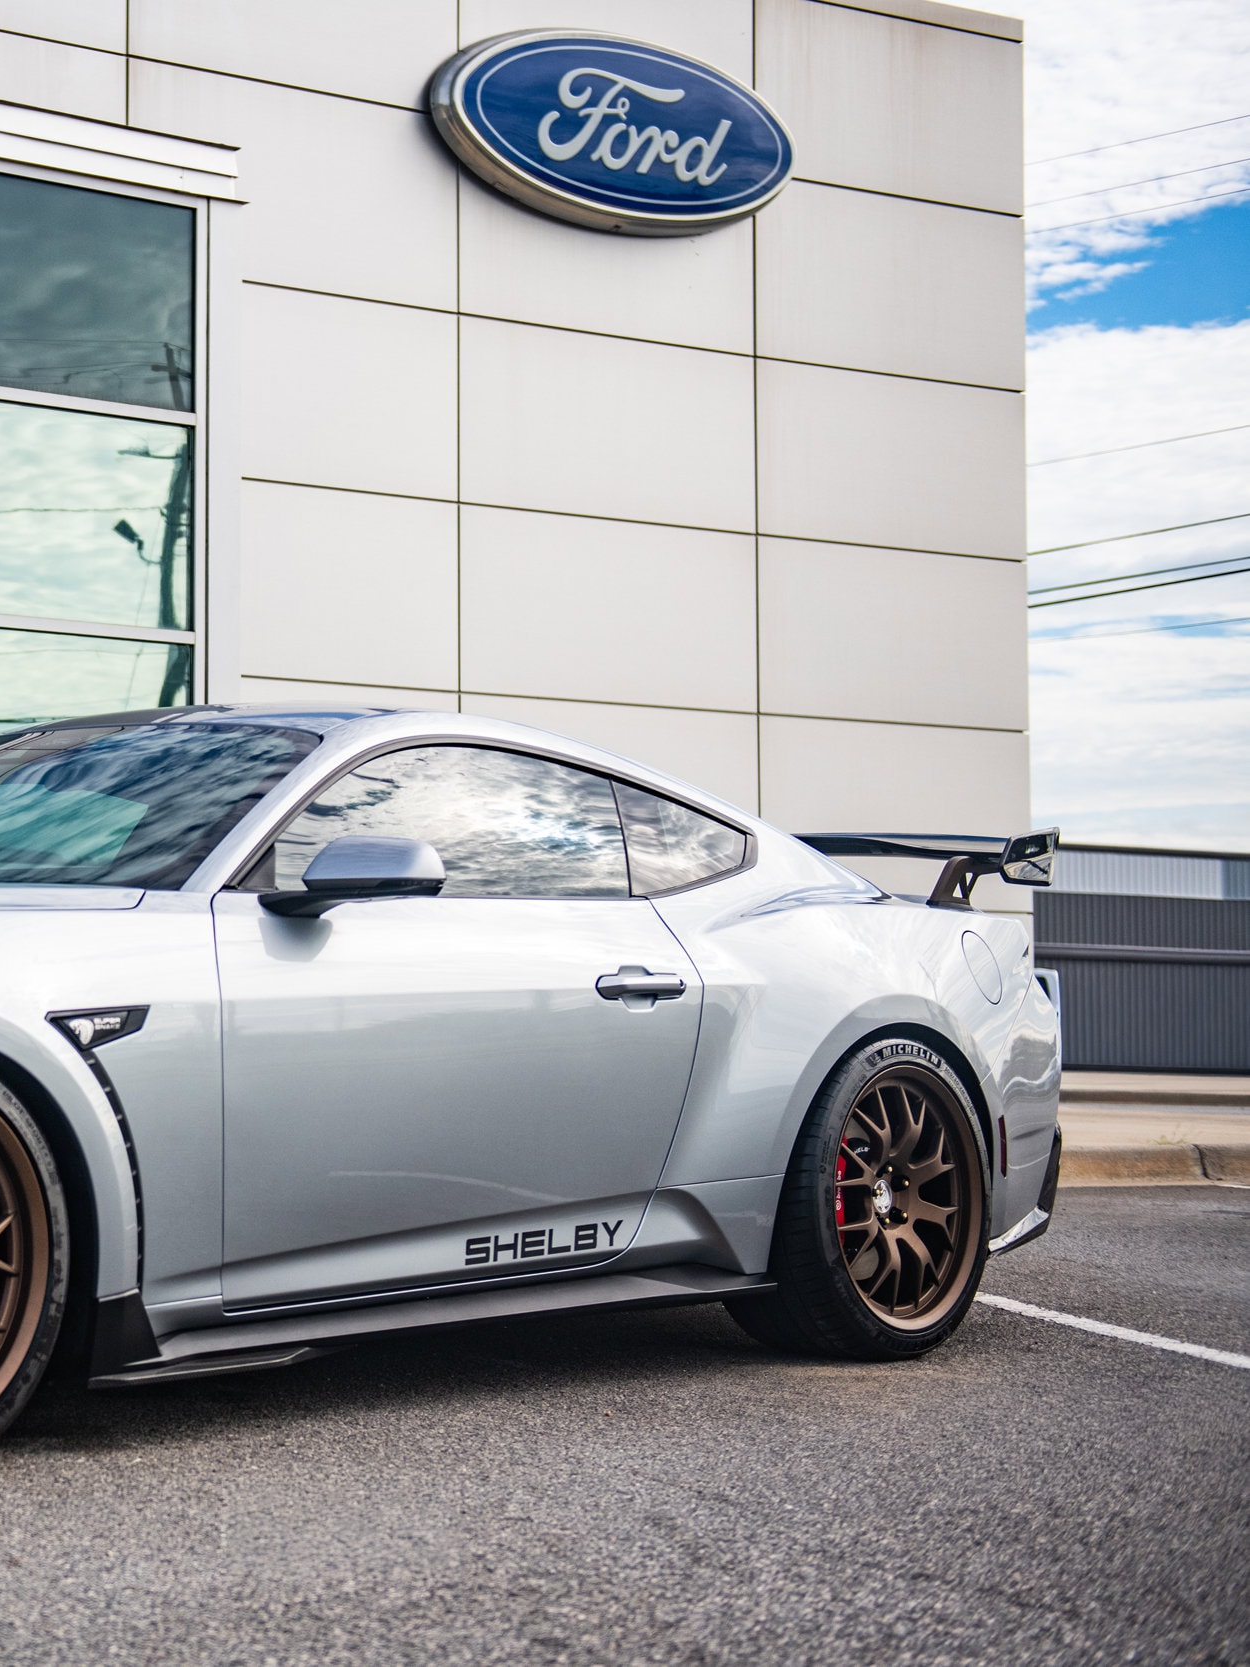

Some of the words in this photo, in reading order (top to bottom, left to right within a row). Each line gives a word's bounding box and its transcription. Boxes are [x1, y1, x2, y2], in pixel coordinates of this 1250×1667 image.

[538, 68, 732, 187] Ford
[882, 1045, 939, 1065] MICHELIN
[465, 1219, 624, 1266] SHELBY
